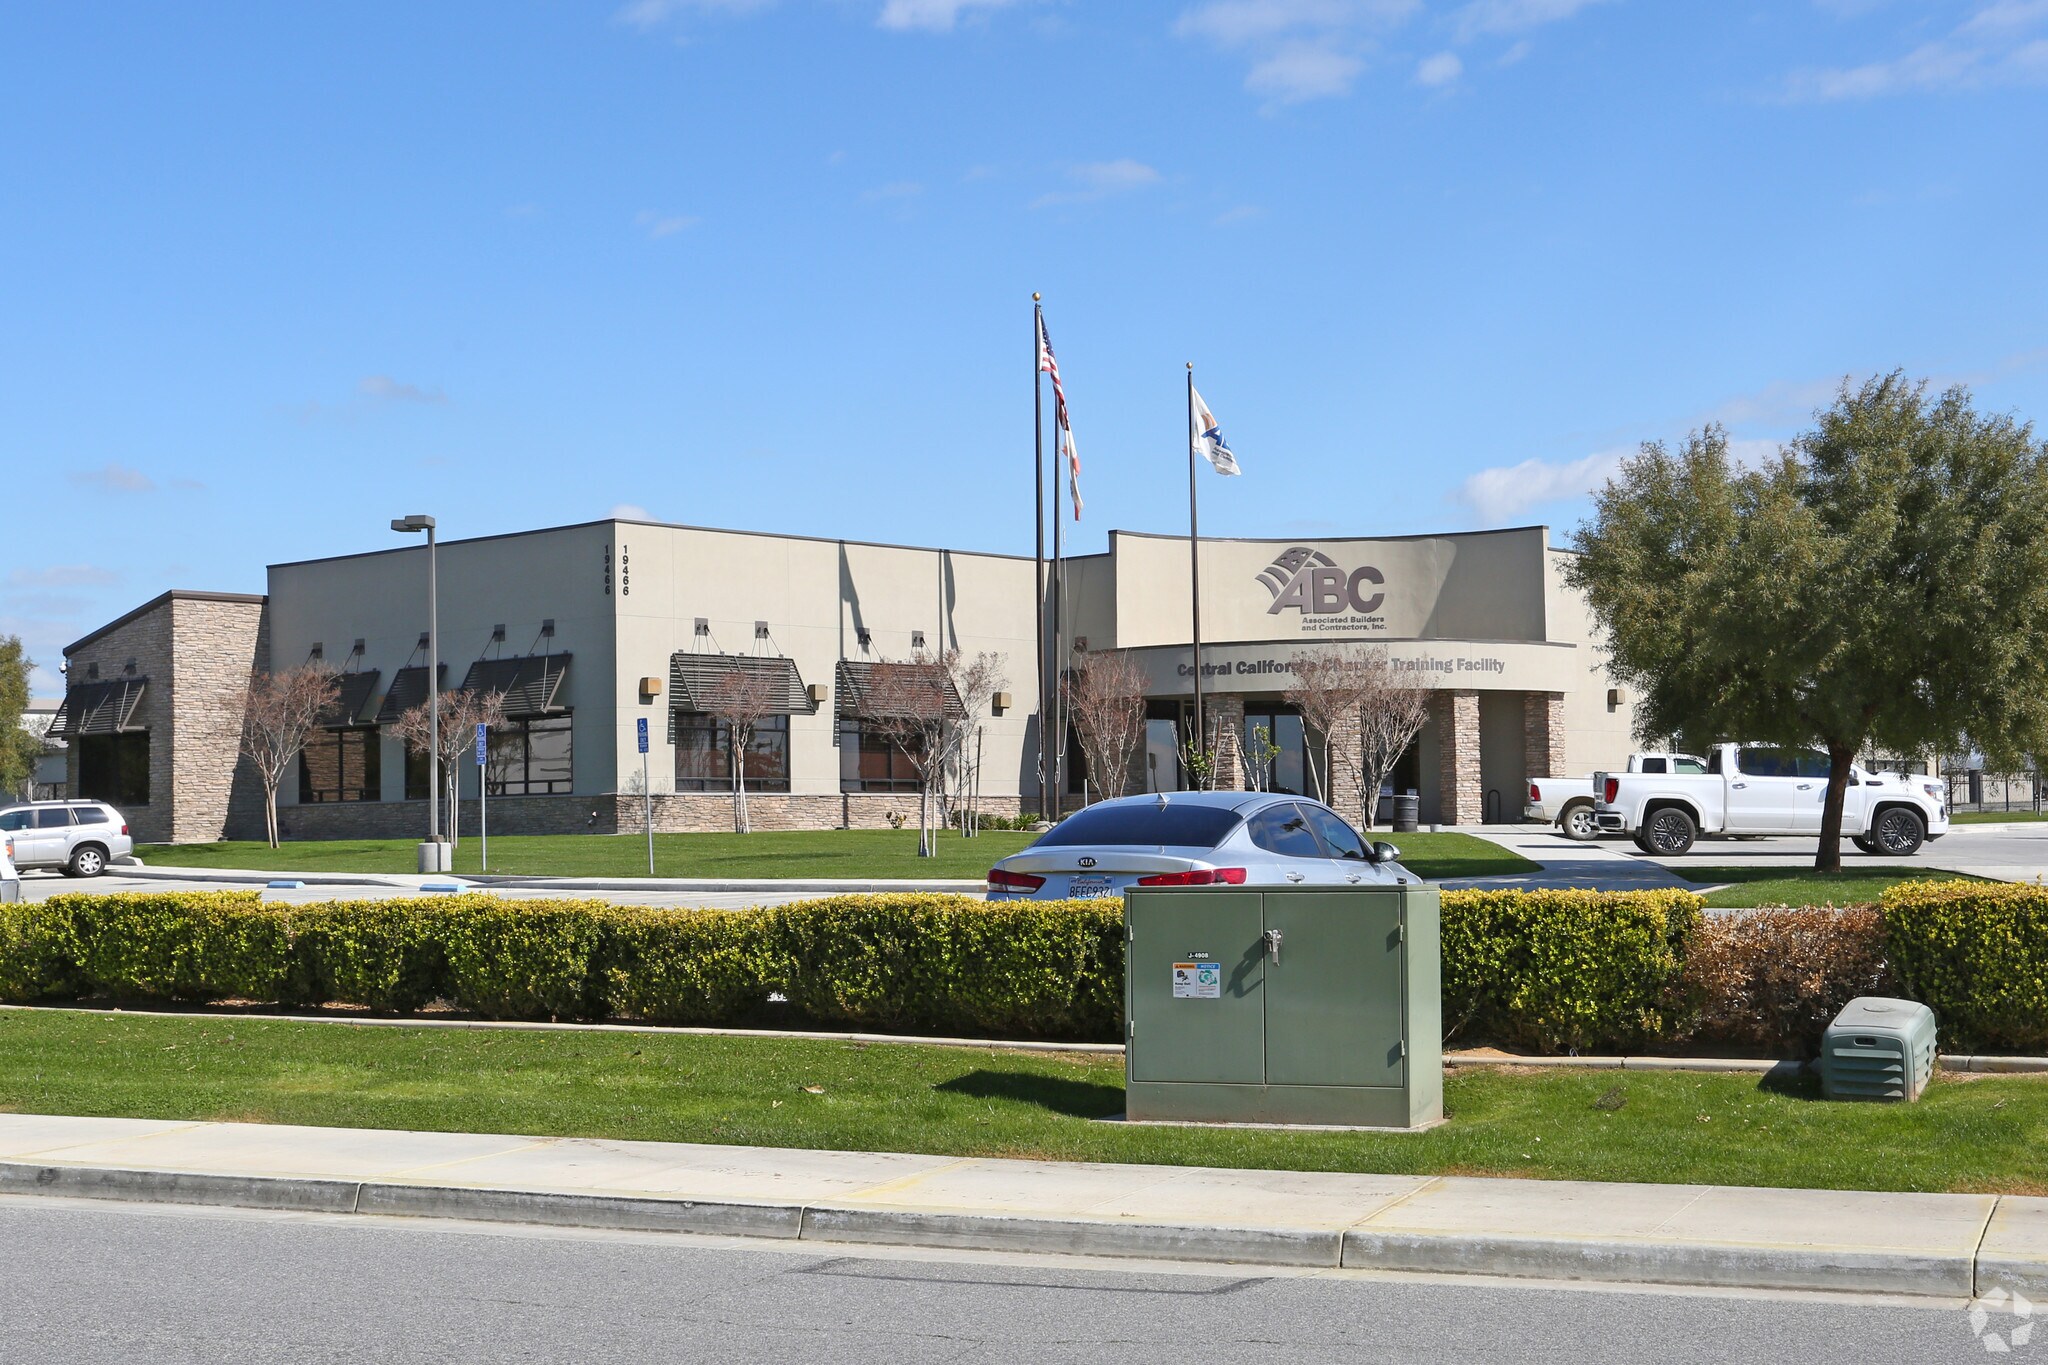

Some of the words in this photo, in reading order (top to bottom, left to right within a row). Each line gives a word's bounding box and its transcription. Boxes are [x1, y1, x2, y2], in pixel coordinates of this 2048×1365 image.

[1266, 566, 1385, 615] ABC
[1302, 616, 1348, 624] Associated
[1350, 615, 1385, 623] Builders
[1236, 659, 1317, 675] Califora
[1391, 657, 1454, 674] Training
[1456, 657, 1506, 674] Facility
[1080, 858, 1094, 866] KIA
